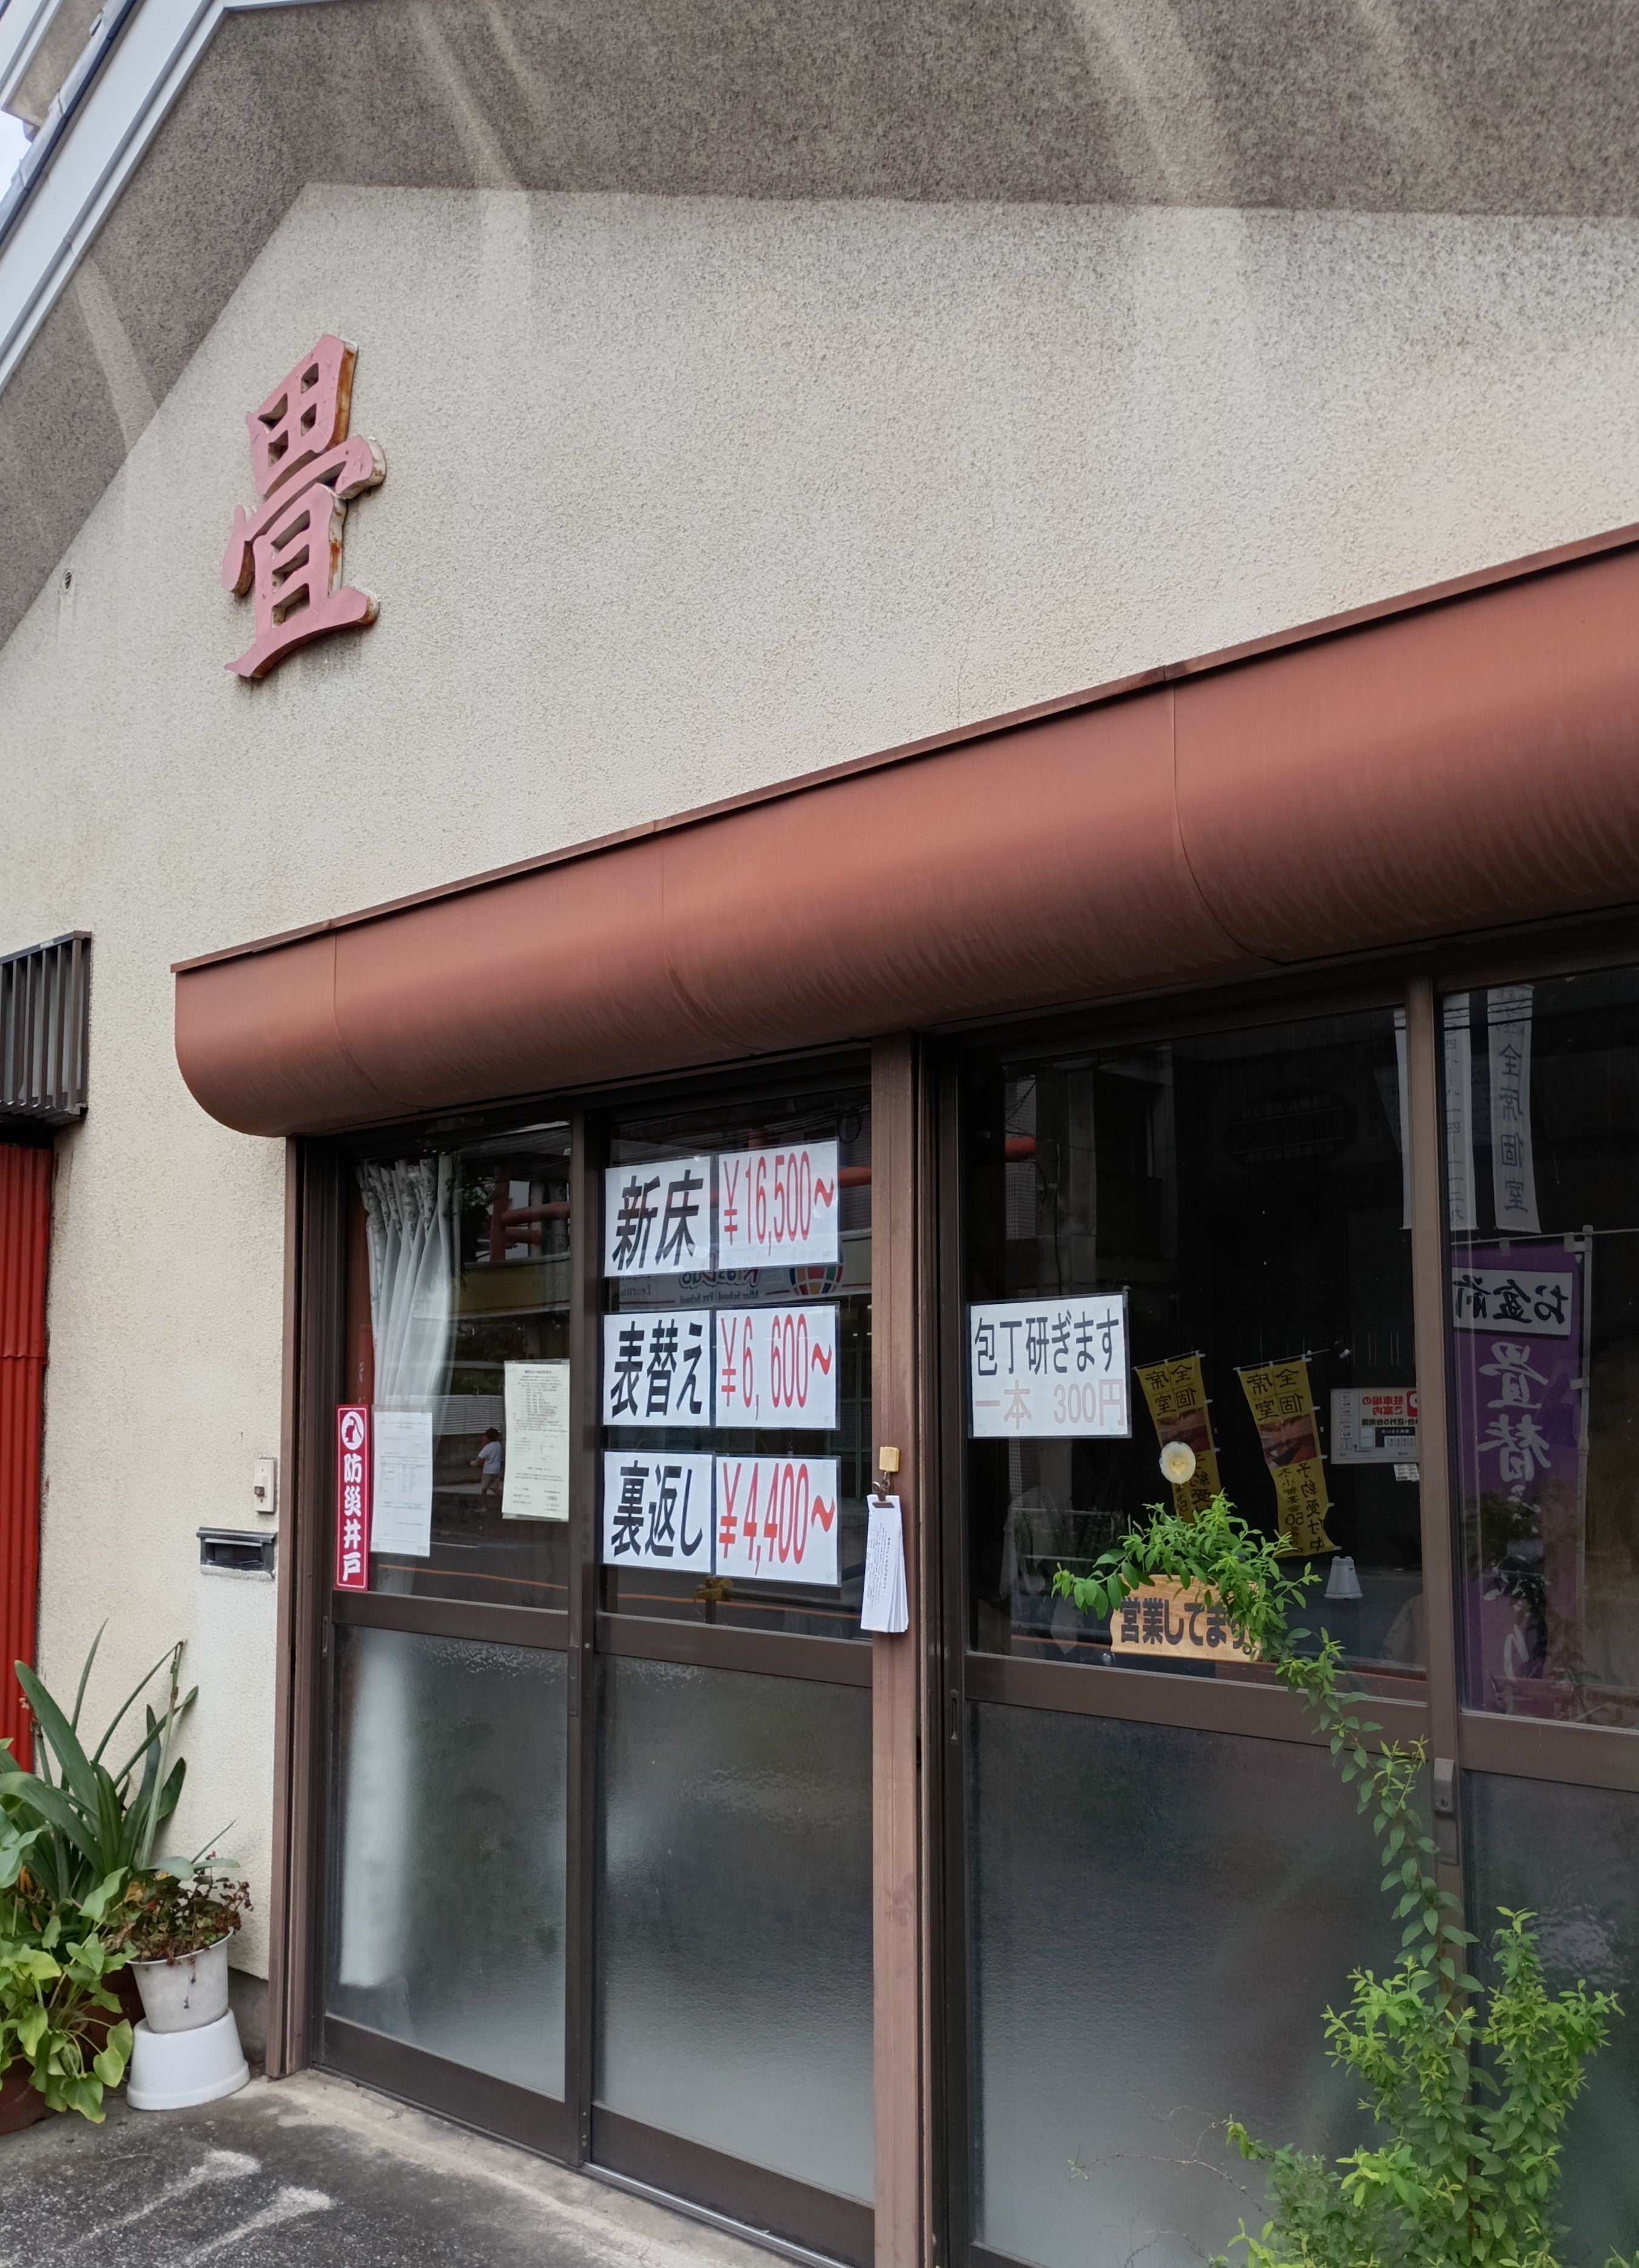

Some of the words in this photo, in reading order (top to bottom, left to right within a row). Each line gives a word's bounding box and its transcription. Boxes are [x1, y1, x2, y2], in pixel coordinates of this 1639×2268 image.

[221, 334, 386, 678] 畳
[611, 1169, 704, 1271] 新床
[611, 1318, 704, 1419] 表替え
[974, 1308, 1120, 1376] 包丁研ぎます
[975, 1380, 1032, 1430] 一本
[1053, 1379, 1125, 1427] 300円
[343, 1453, 362, 1582] 防災井戸
[611, 1460, 704, 1558] 裏返し
